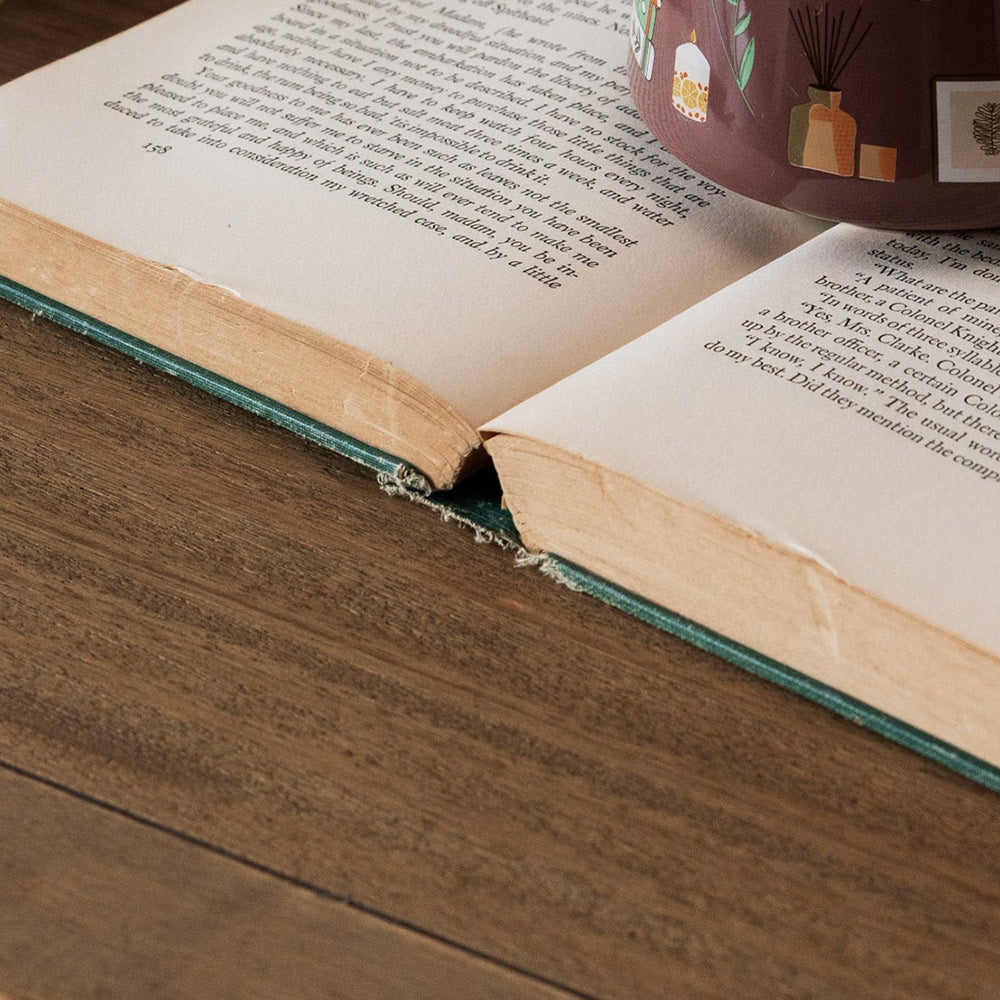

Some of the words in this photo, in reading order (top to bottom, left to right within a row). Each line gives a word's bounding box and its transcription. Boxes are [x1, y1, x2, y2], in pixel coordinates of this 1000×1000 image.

[142, 142, 173, 154] 158
[338, 100, 358, 110] so
[354, 104, 389, 122] bad,
[406, 123, 481, 155] impossible
[477, 150, 497, 161] to
[494, 157, 537, 179] drink
[531, 172, 550, 185] it.
[355, 123, 388, 137] ever
[386, 132, 423, 151] been
[421, 147, 458, 164] such
[456, 161, 477, 171] as
[475, 166, 521, 190] leaves
[519, 187, 551, 203] not
[547, 199, 577, 215] the
[575, 214, 638, 248] smallest
[348, 189, 418, 218] wretched
[413, 216, 448, 236] case,
[483, 245, 508, 260] by
[507, 259, 523, 268] a
[521, 264, 562, 289] little
[941, 242, 970, 256] the
[813, 274, 873, 303] brother,
[873, 298, 887, 307] a
[887, 301, 954, 331] Colonel
[920, 282, 949, 295] are
[947, 289, 976, 305] the
[836, 316, 871, 337] Mrs.
[876, 332, 930, 363] Clarke.
[841, 302, 888, 324] words
[885, 320, 912, 331] of
[904, 325, 948, 349] three
[702, 339, 726, 353] do
[723, 348, 752, 364] my
[750, 356, 786, 378] best.
[787, 371, 825, 392] Did
[819, 387, 858, 410] they
[855, 405, 924, 444] mention
[923, 438, 954, 457] the
